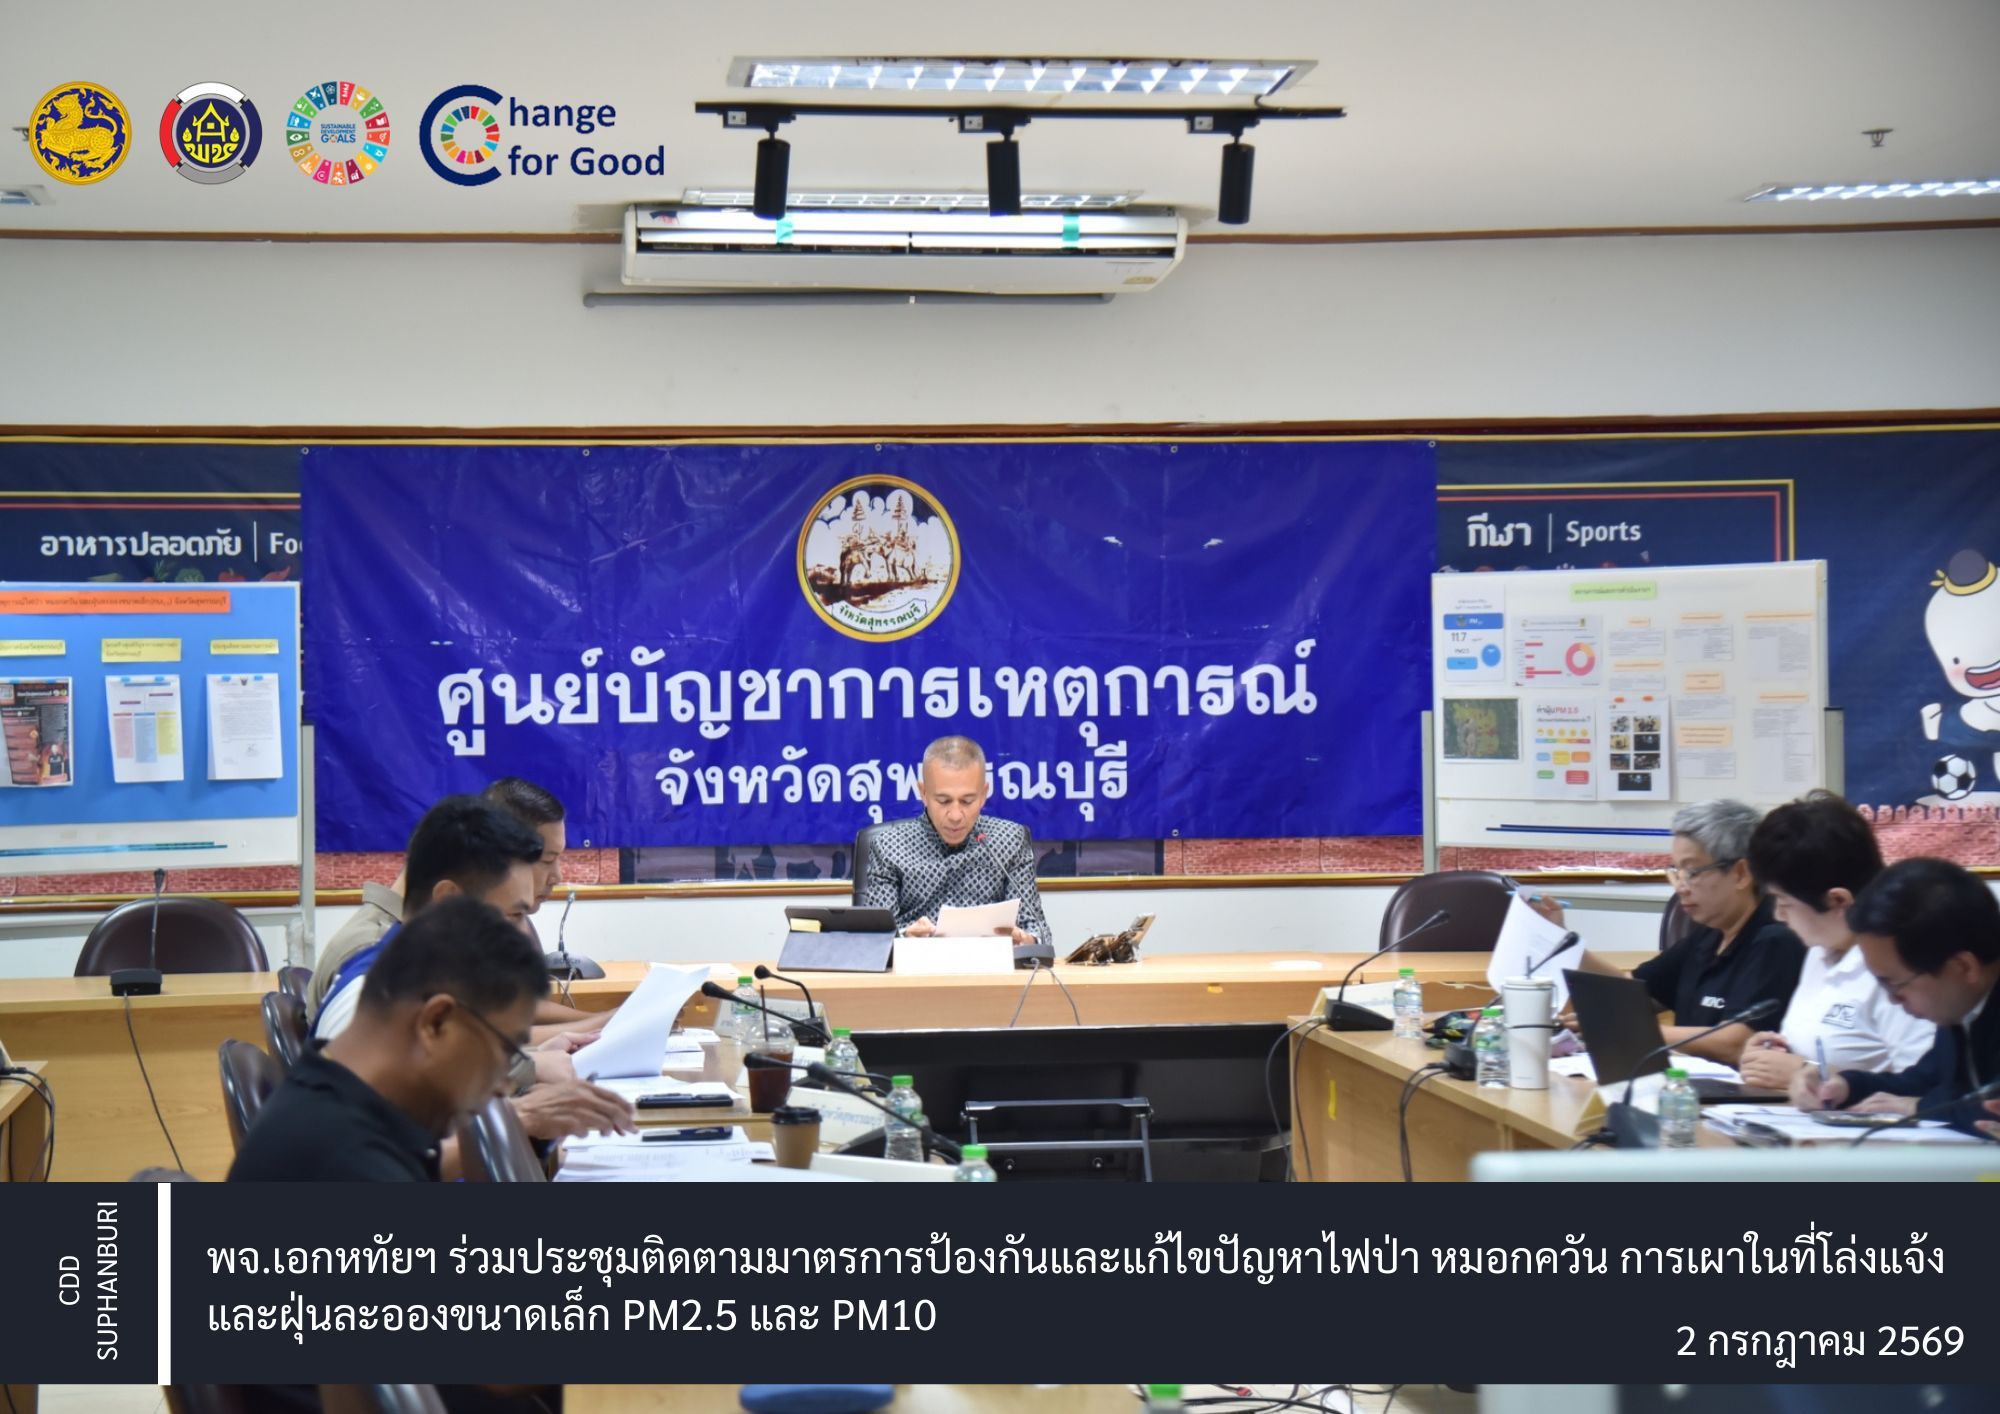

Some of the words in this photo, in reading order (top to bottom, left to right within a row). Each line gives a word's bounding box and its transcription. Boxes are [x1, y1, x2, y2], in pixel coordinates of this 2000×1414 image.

[40, 528, 242, 556] อาหารปลอดภัย
[1467, 512, 1533, 547] กีฬา
[1565, 520, 1642, 546] Sports
[438, 638, 1317, 757] ศูนย์บัญชาการเหตุการณ์
[656, 741, 1128, 823] จังหวัดสุพณบุรี
